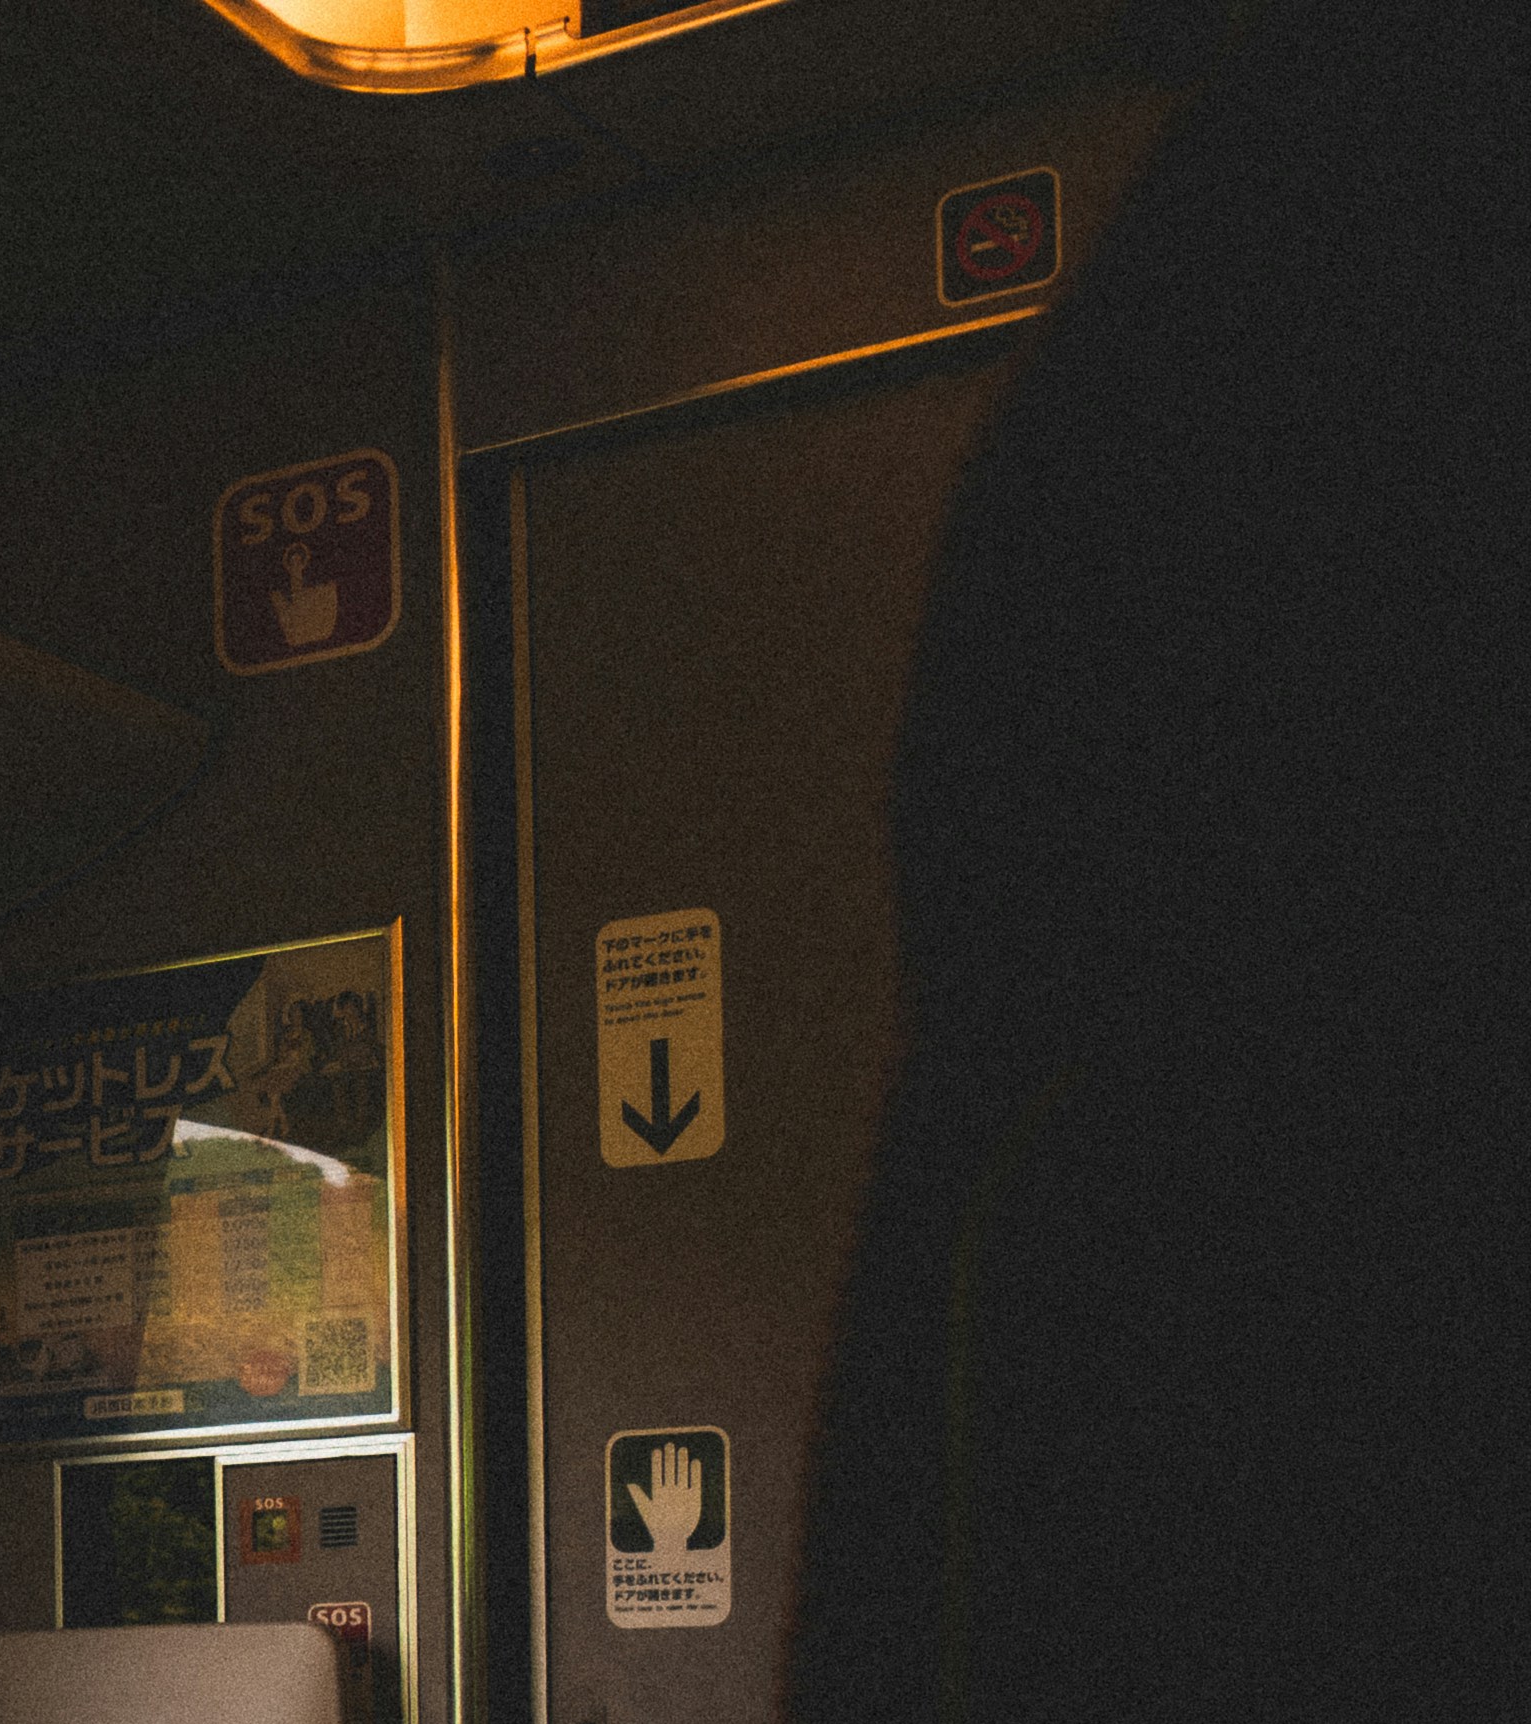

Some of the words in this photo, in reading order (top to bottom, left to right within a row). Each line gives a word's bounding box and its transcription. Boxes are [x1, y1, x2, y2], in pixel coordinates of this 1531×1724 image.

[238, 469, 373, 546] SOS
[254, 1497, 285, 1510] SOS
[315, 1607, 363, 1627] SOS
